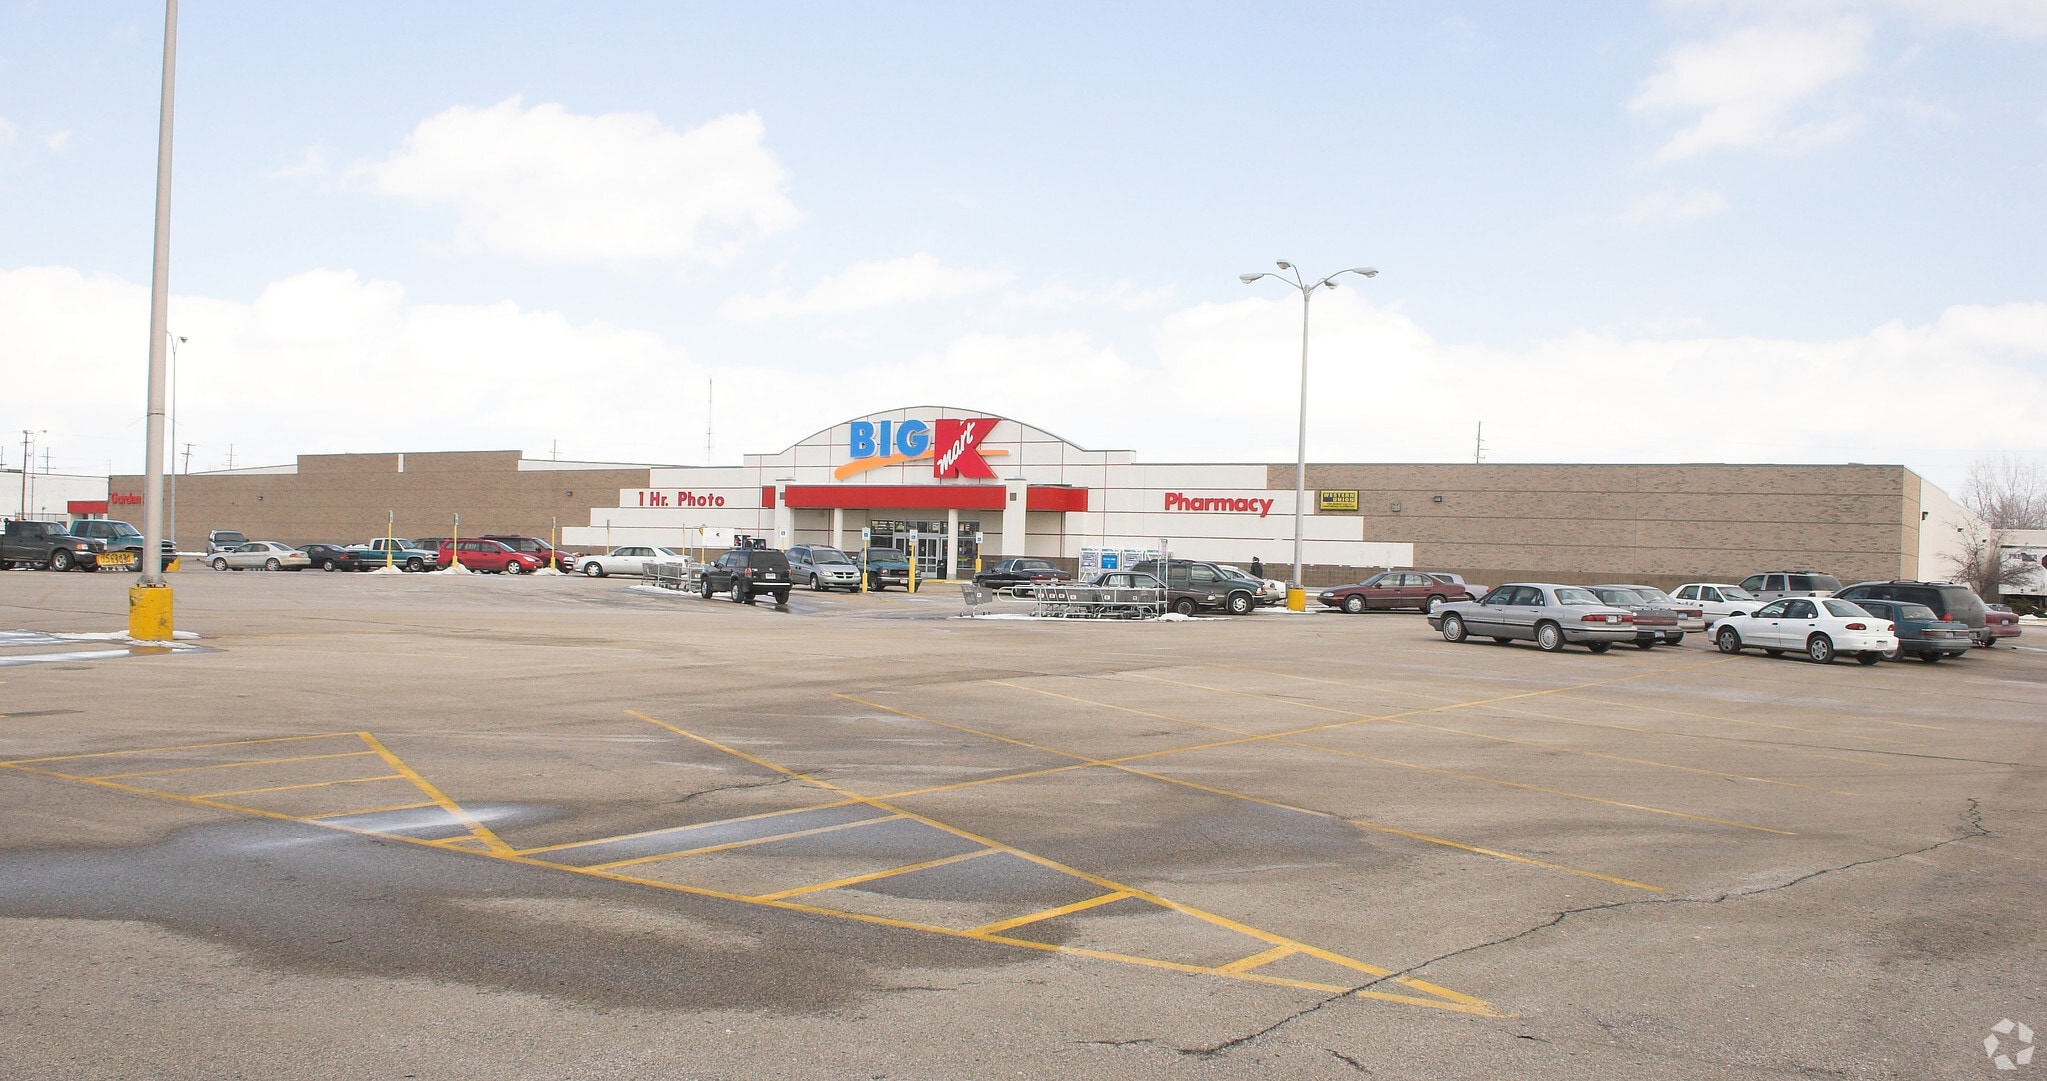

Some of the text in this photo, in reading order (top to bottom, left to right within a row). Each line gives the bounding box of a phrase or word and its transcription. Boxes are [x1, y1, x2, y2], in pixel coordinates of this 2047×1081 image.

[850, 418, 1000, 478] BIG K
[937, 421, 976, 475] mart
[111, 492, 142, 504] Garden
[639, 491, 725, 507] 1 Hr. Photo
[1165, 492, 1275, 518] Pharmacy
